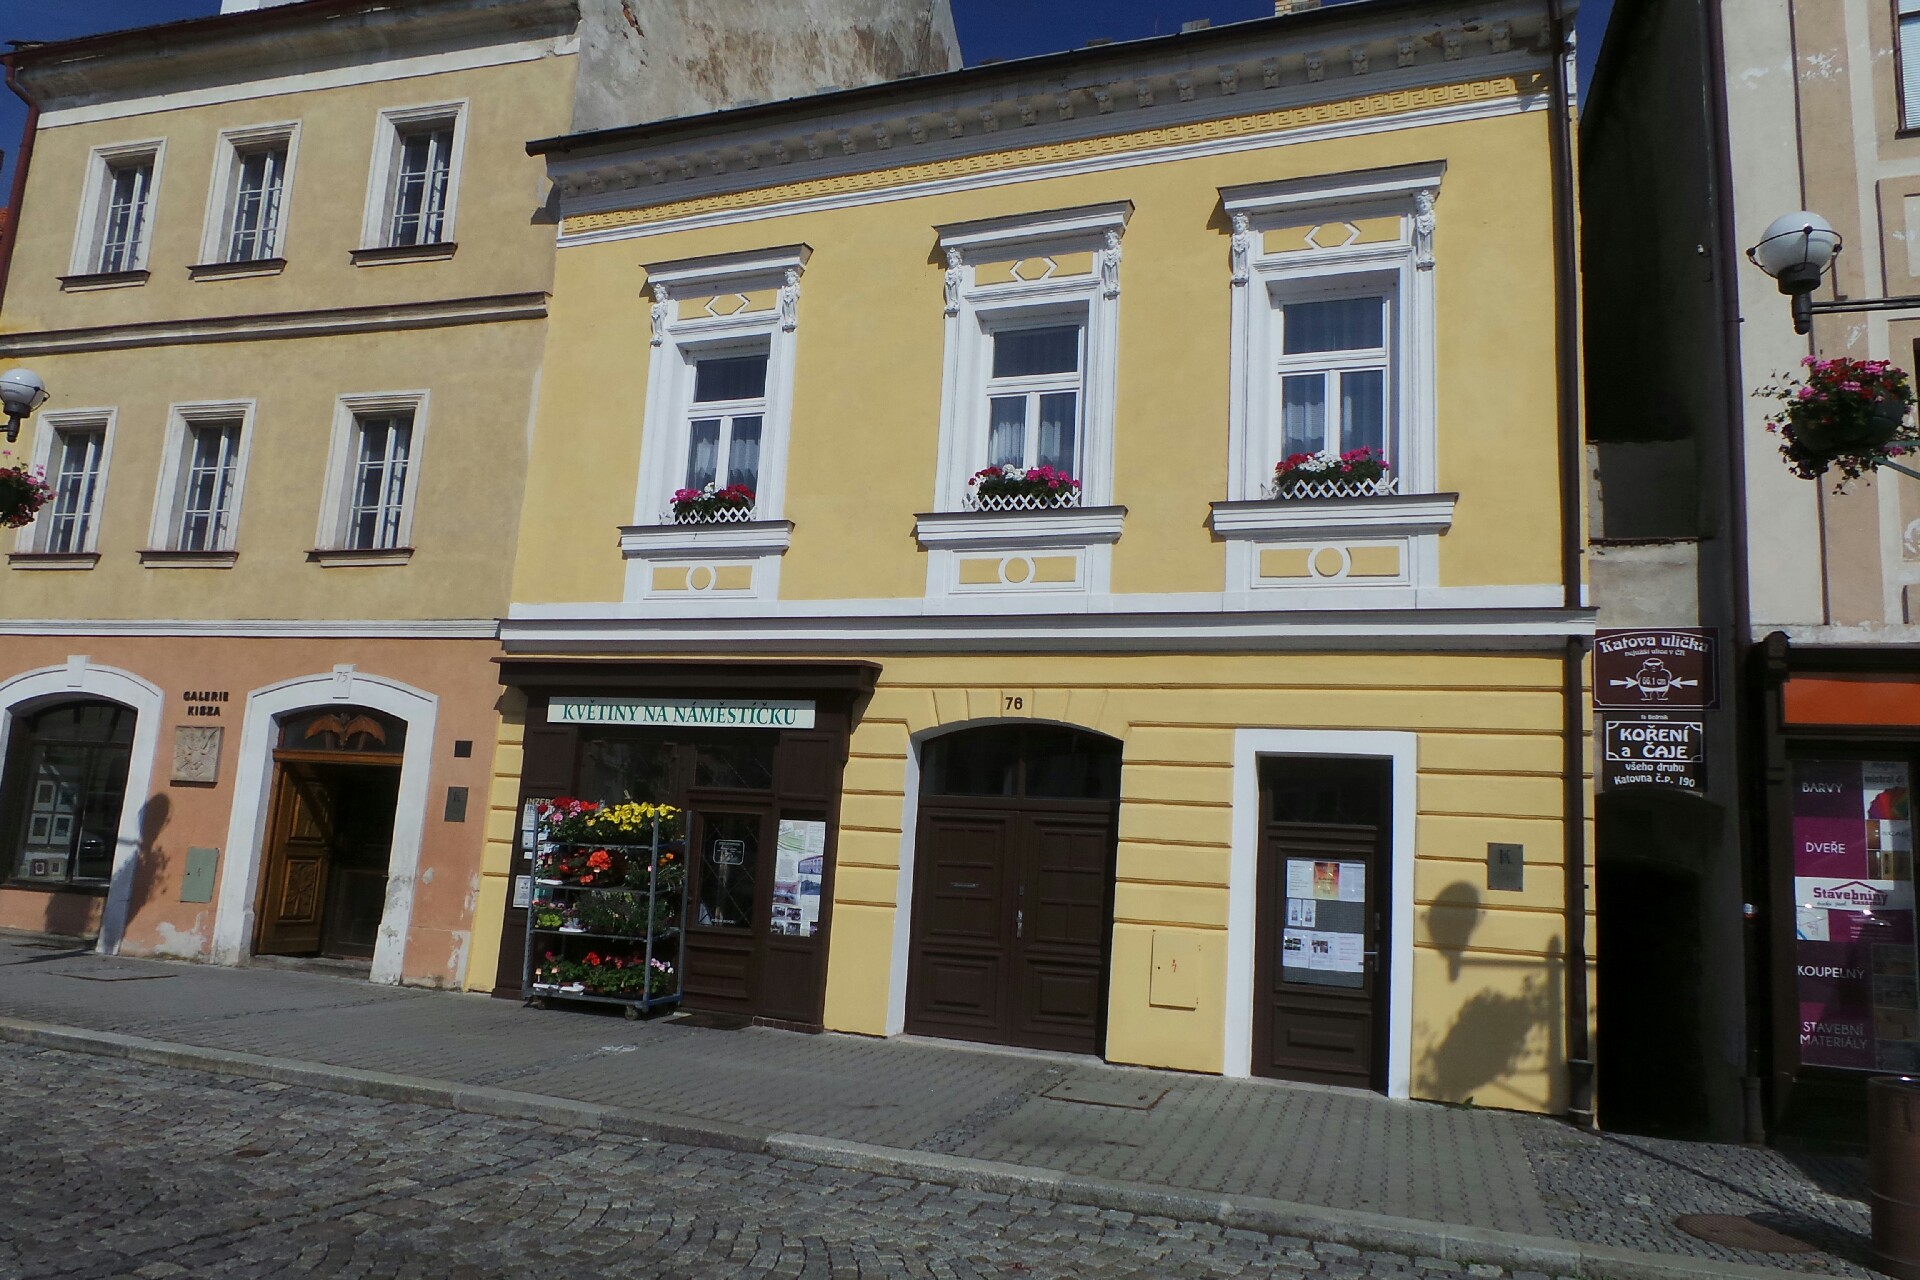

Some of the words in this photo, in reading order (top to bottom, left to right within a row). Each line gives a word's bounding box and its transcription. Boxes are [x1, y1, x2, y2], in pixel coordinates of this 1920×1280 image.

[1600, 636, 1656, 653] Katova
[1661, 635, 1709, 652] ulička
[336, 672, 350, 683] 75
[183, 691, 229, 702] GALERIE
[1005, 696, 1023, 711] 76
[562, 699, 639, 721] KVĚTINY
[642, 705, 668, 722] NA
[672, 701, 797, 725] NÁMĚSTÍČKU
[1620, 725, 1690, 742] KOŘENÍ
[1621, 746, 1631, 757] a
[1642, 741, 1689, 759] ČAJE
[1625, 761, 1654, 772] všeho
[1656, 763, 1685, 773] druhu
[1614, 774, 1653, 785] Katovna
[1655, 773, 1674, 785] č.p.
[1679, 776, 1696, 788] 190
[1802, 782, 1843, 793] BARVY
[1805, 841, 1847, 855] DVEŘE
[1813, 887, 1888, 906] Stavebniny
[1797, 965, 1865, 979] KOUPELNY
[1803, 1021, 1864, 1036] STAVEBNÍ
[1800, 1034, 1868, 1049] MATERIÁLY
